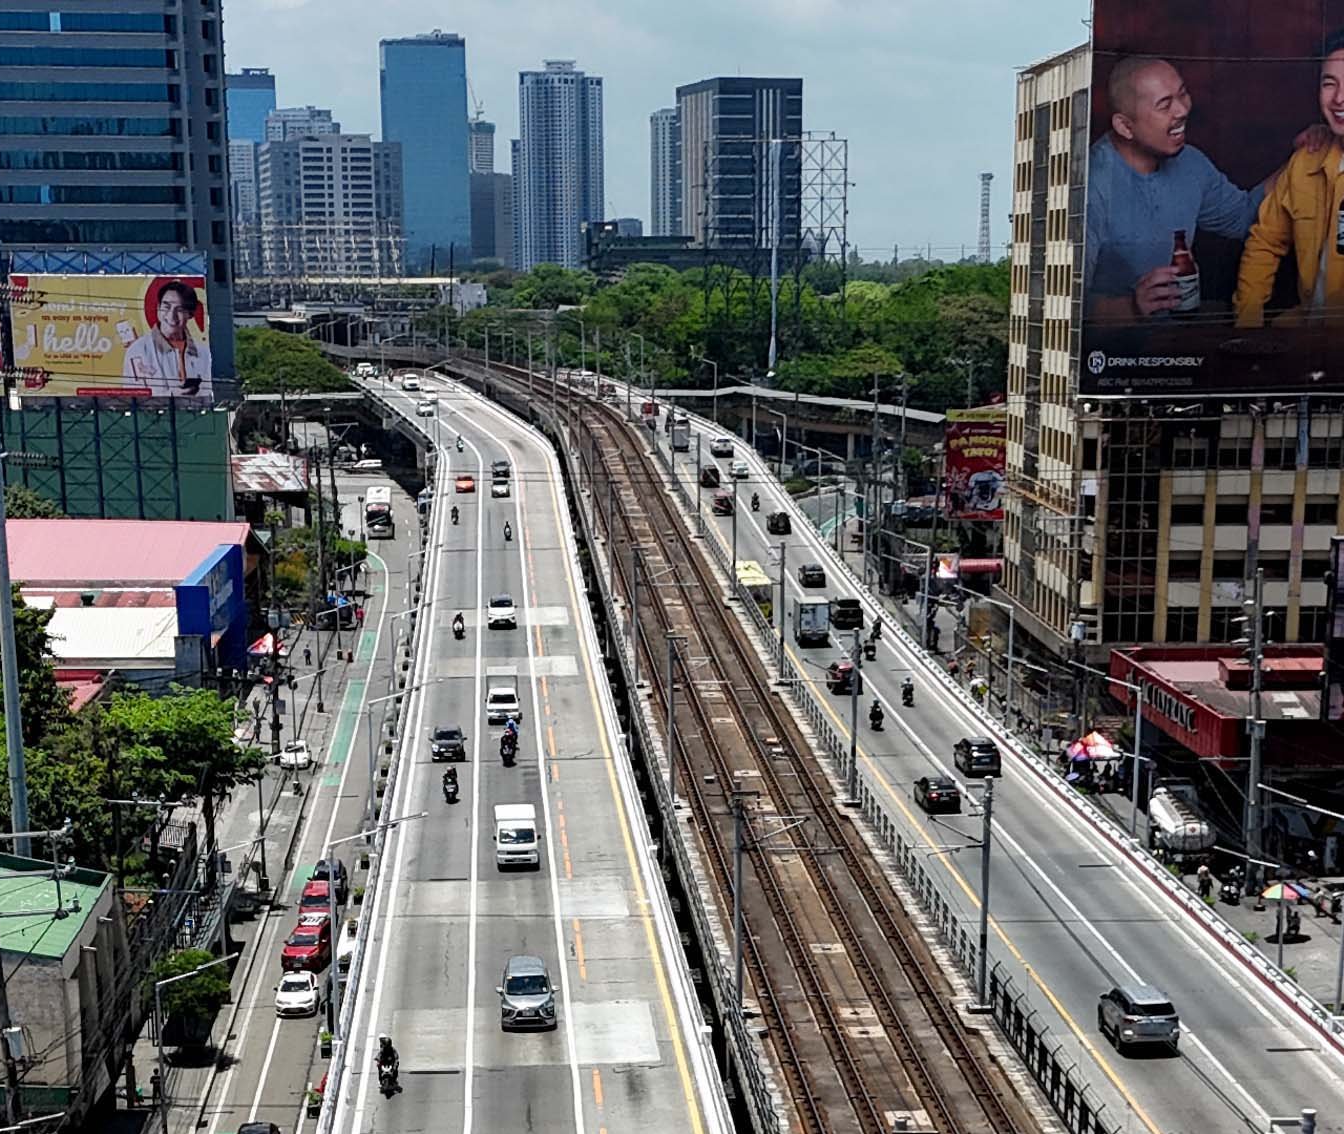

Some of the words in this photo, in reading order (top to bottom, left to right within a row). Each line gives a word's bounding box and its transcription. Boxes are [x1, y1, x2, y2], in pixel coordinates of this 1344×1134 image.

[43, 323, 113, 353] hello
[1107, 357, 1137, 367] DRINK
[1138, 356, 1205, 367] RESPONSIBLY
